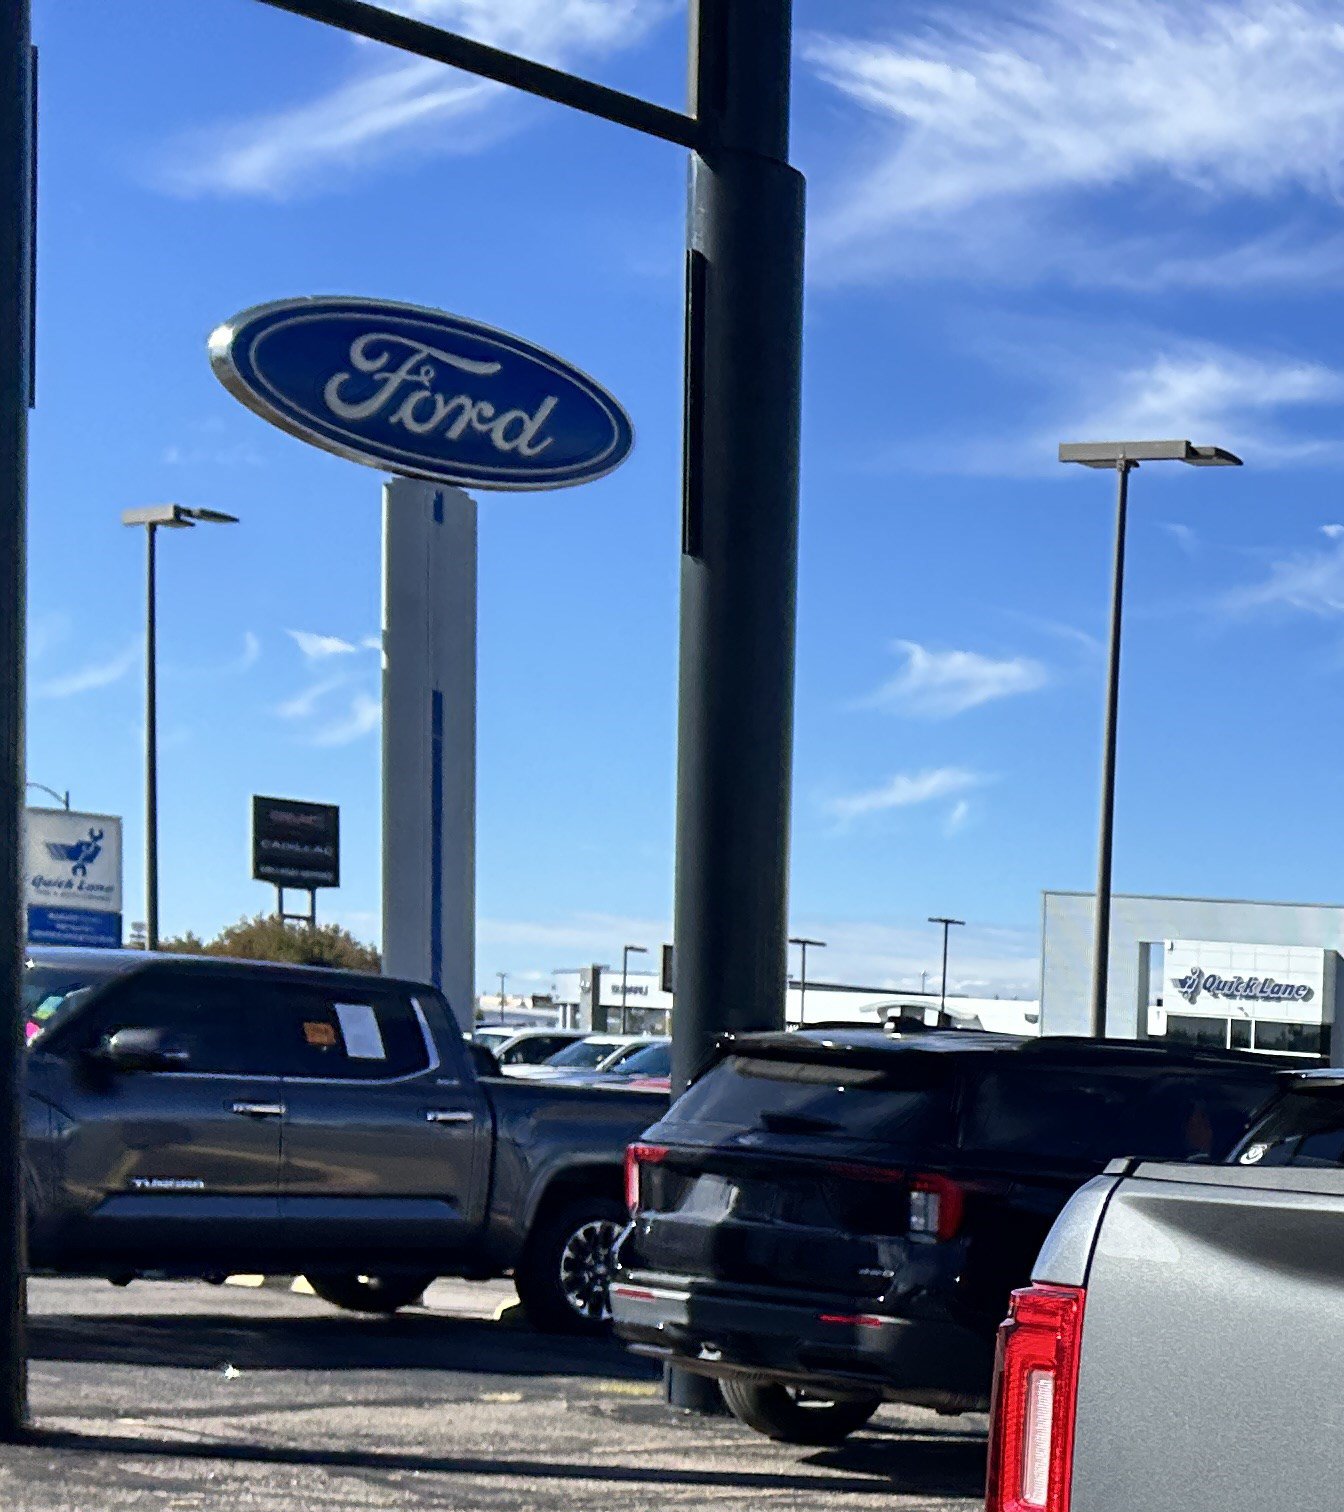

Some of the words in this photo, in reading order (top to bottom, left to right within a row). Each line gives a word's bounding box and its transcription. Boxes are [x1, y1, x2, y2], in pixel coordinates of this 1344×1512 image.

[324, 332, 558, 456] Ford
[31, 874, 74, 890] Quick
[1202, 973, 1258, 996] Quick
[1258, 977, 1309, 999] Lane
